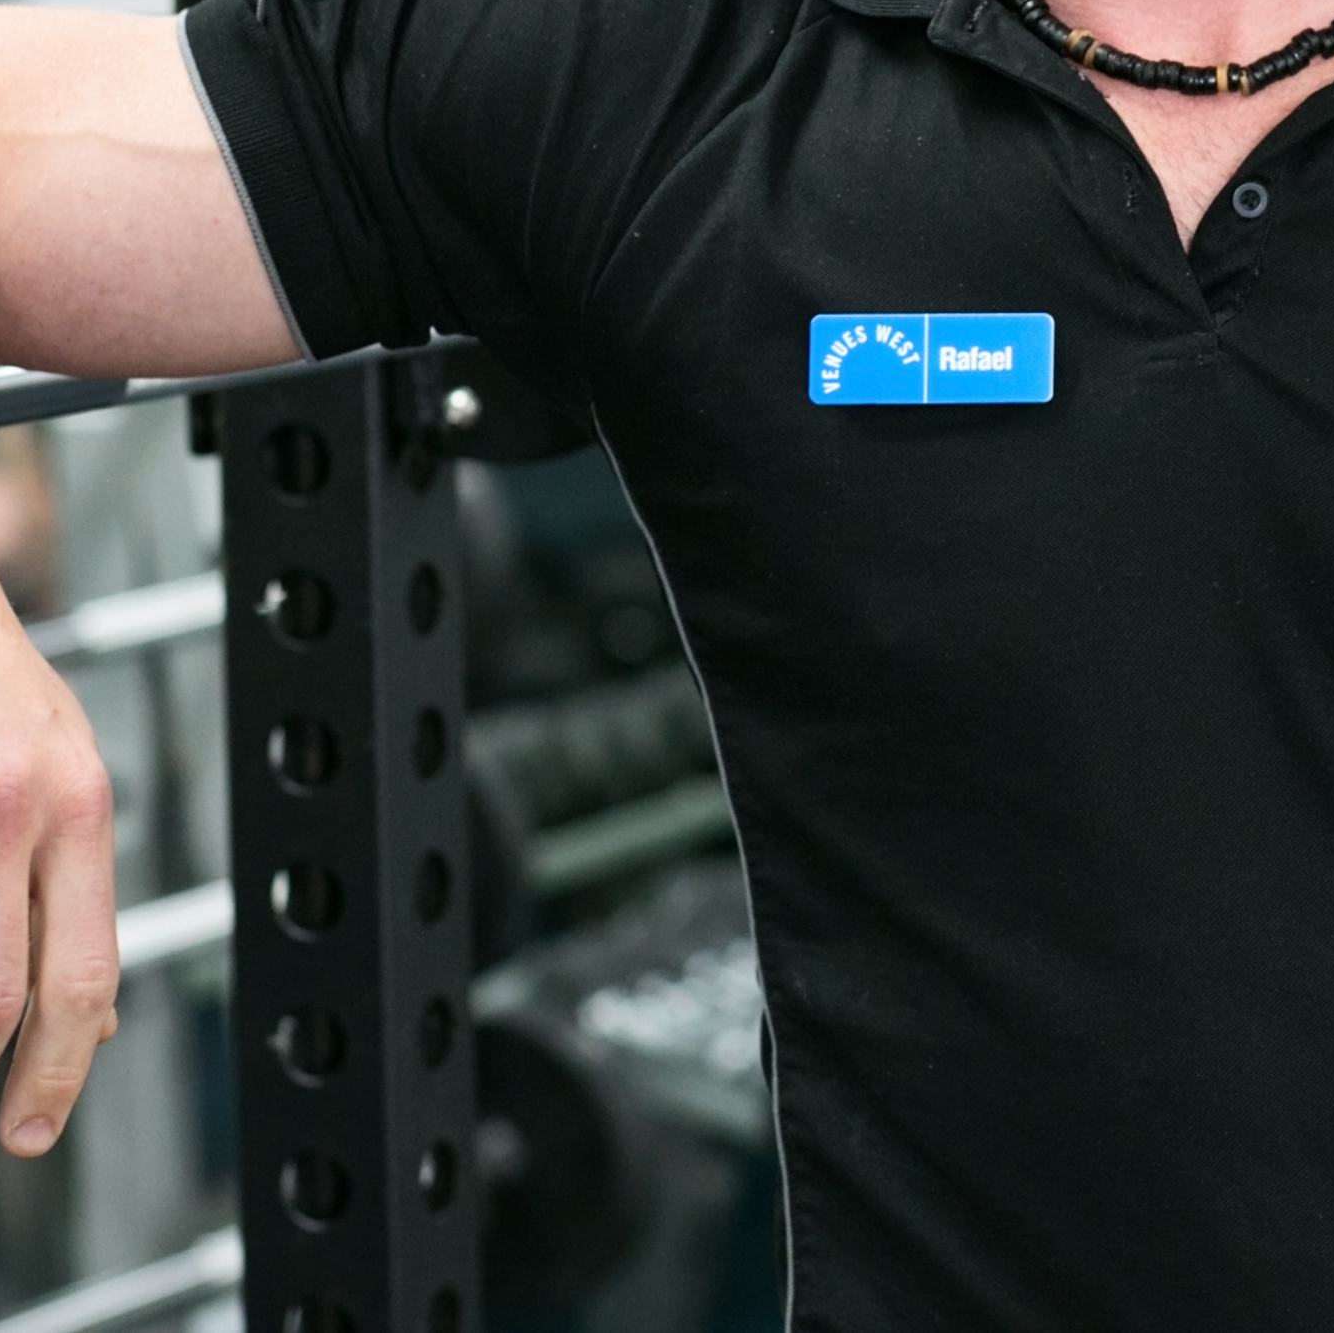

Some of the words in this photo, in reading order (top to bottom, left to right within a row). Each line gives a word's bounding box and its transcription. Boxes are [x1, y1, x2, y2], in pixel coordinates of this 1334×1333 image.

[821, 323, 869, 395] VENUES
[874, 322, 922, 366] WEST
[938, 345, 1014, 372] Rafael
